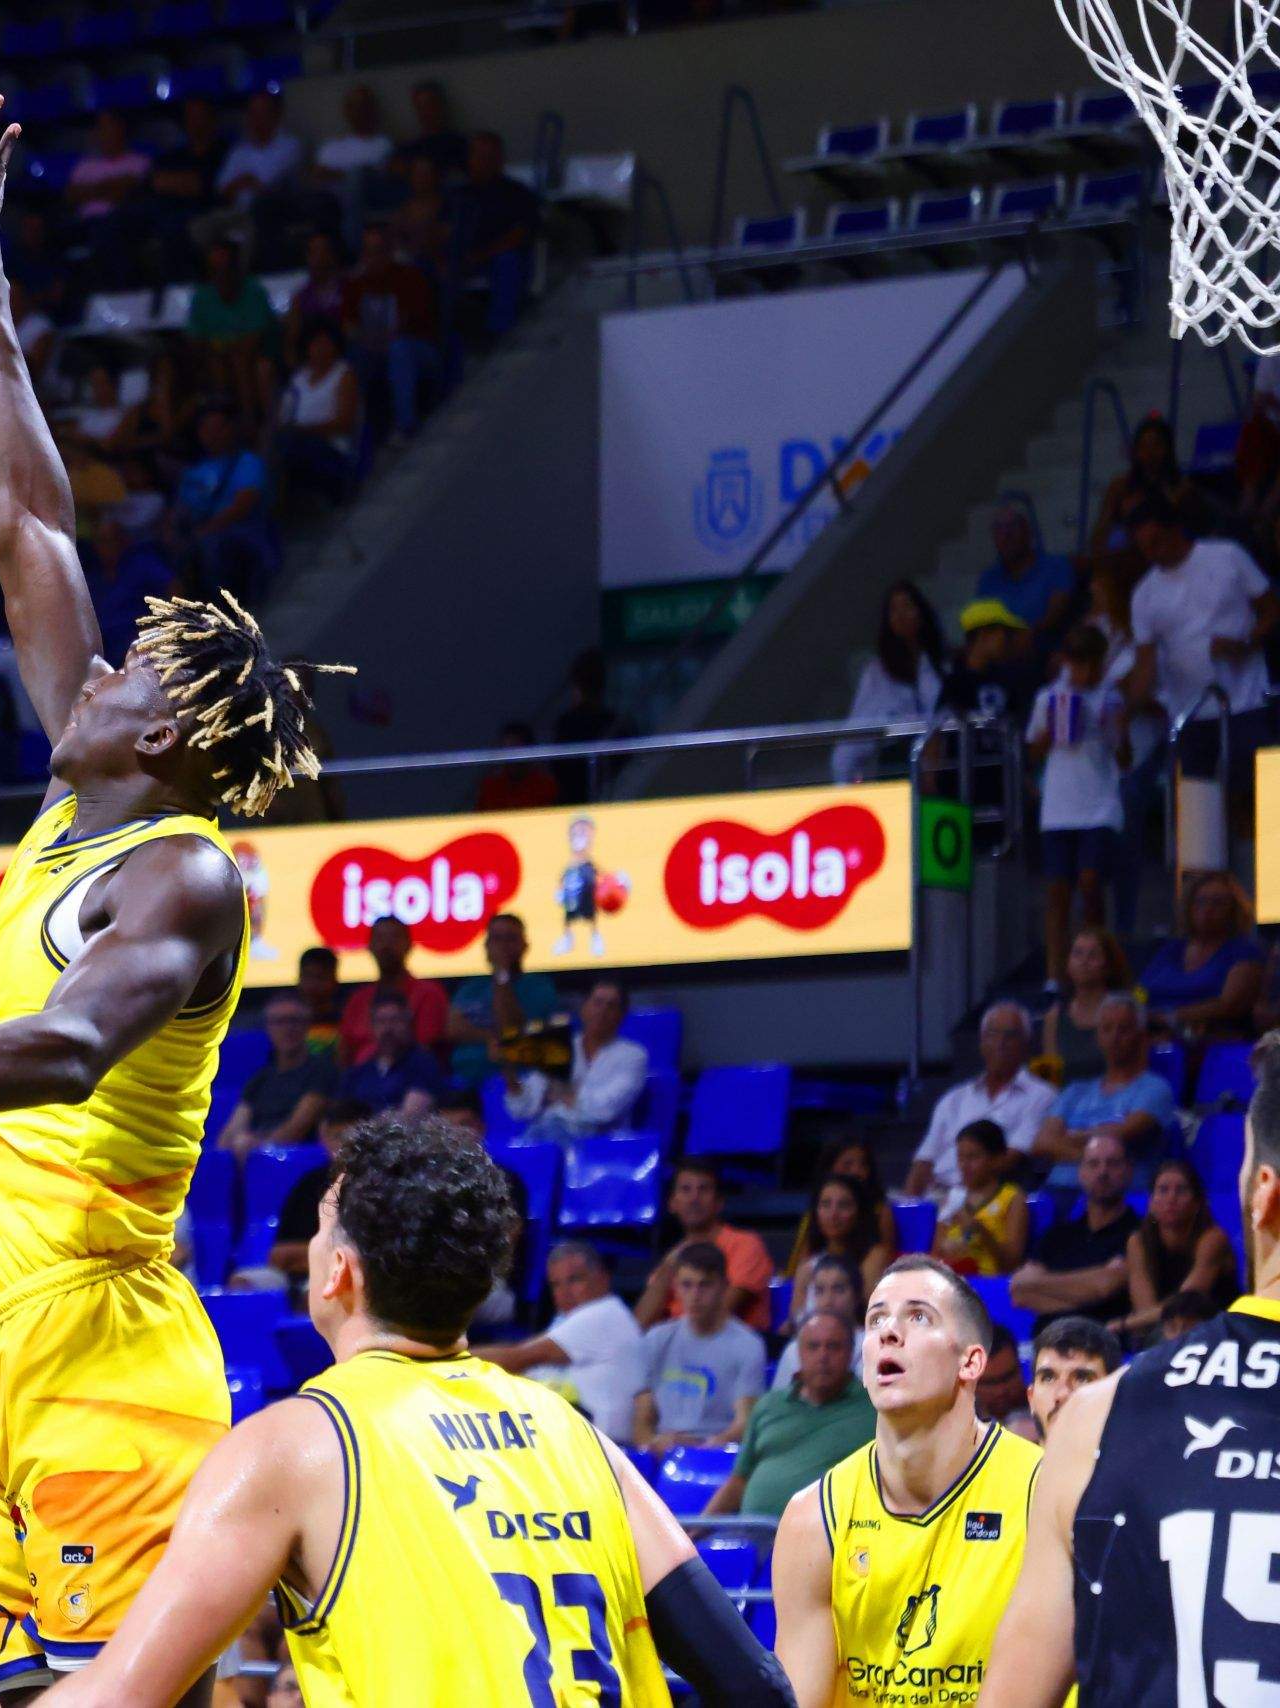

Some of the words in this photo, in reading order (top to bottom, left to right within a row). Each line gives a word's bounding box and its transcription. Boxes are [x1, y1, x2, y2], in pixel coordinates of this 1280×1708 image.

[342, 856, 484, 928] isola
[699, 830, 847, 906] isola
[429, 1411, 537, 1451] MUTAF
[63, 1550, 87, 1563] acb
[1159, 1509, 1280, 1708] 15
[910, 1690, 934, 1705] del
